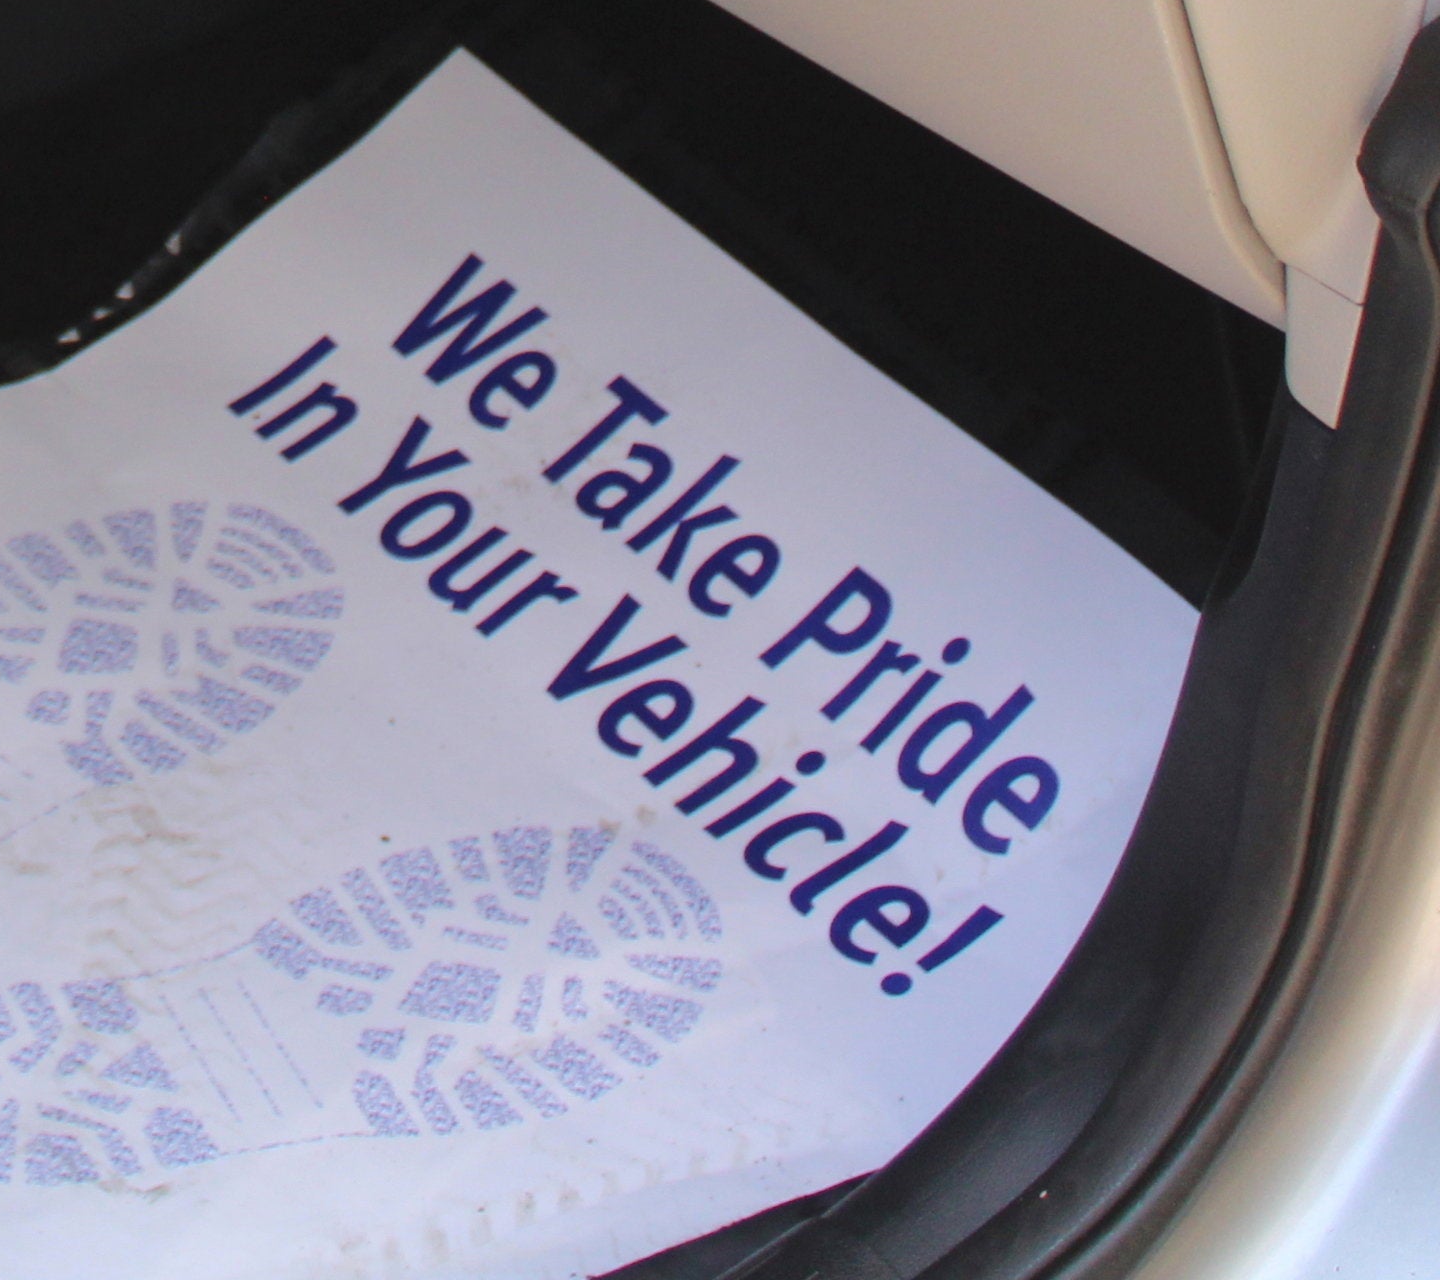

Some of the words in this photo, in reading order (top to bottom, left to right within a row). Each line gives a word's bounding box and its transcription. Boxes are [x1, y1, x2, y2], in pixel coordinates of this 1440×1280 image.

[227, 336, 359, 464] In
[336, 415, 580, 639] Your
[547, 594, 1006, 999] Vehicle!
[391, 252, 558, 432] We
[541, 375, 782, 619] Take
[759, 567, 1062, 857] Pride
